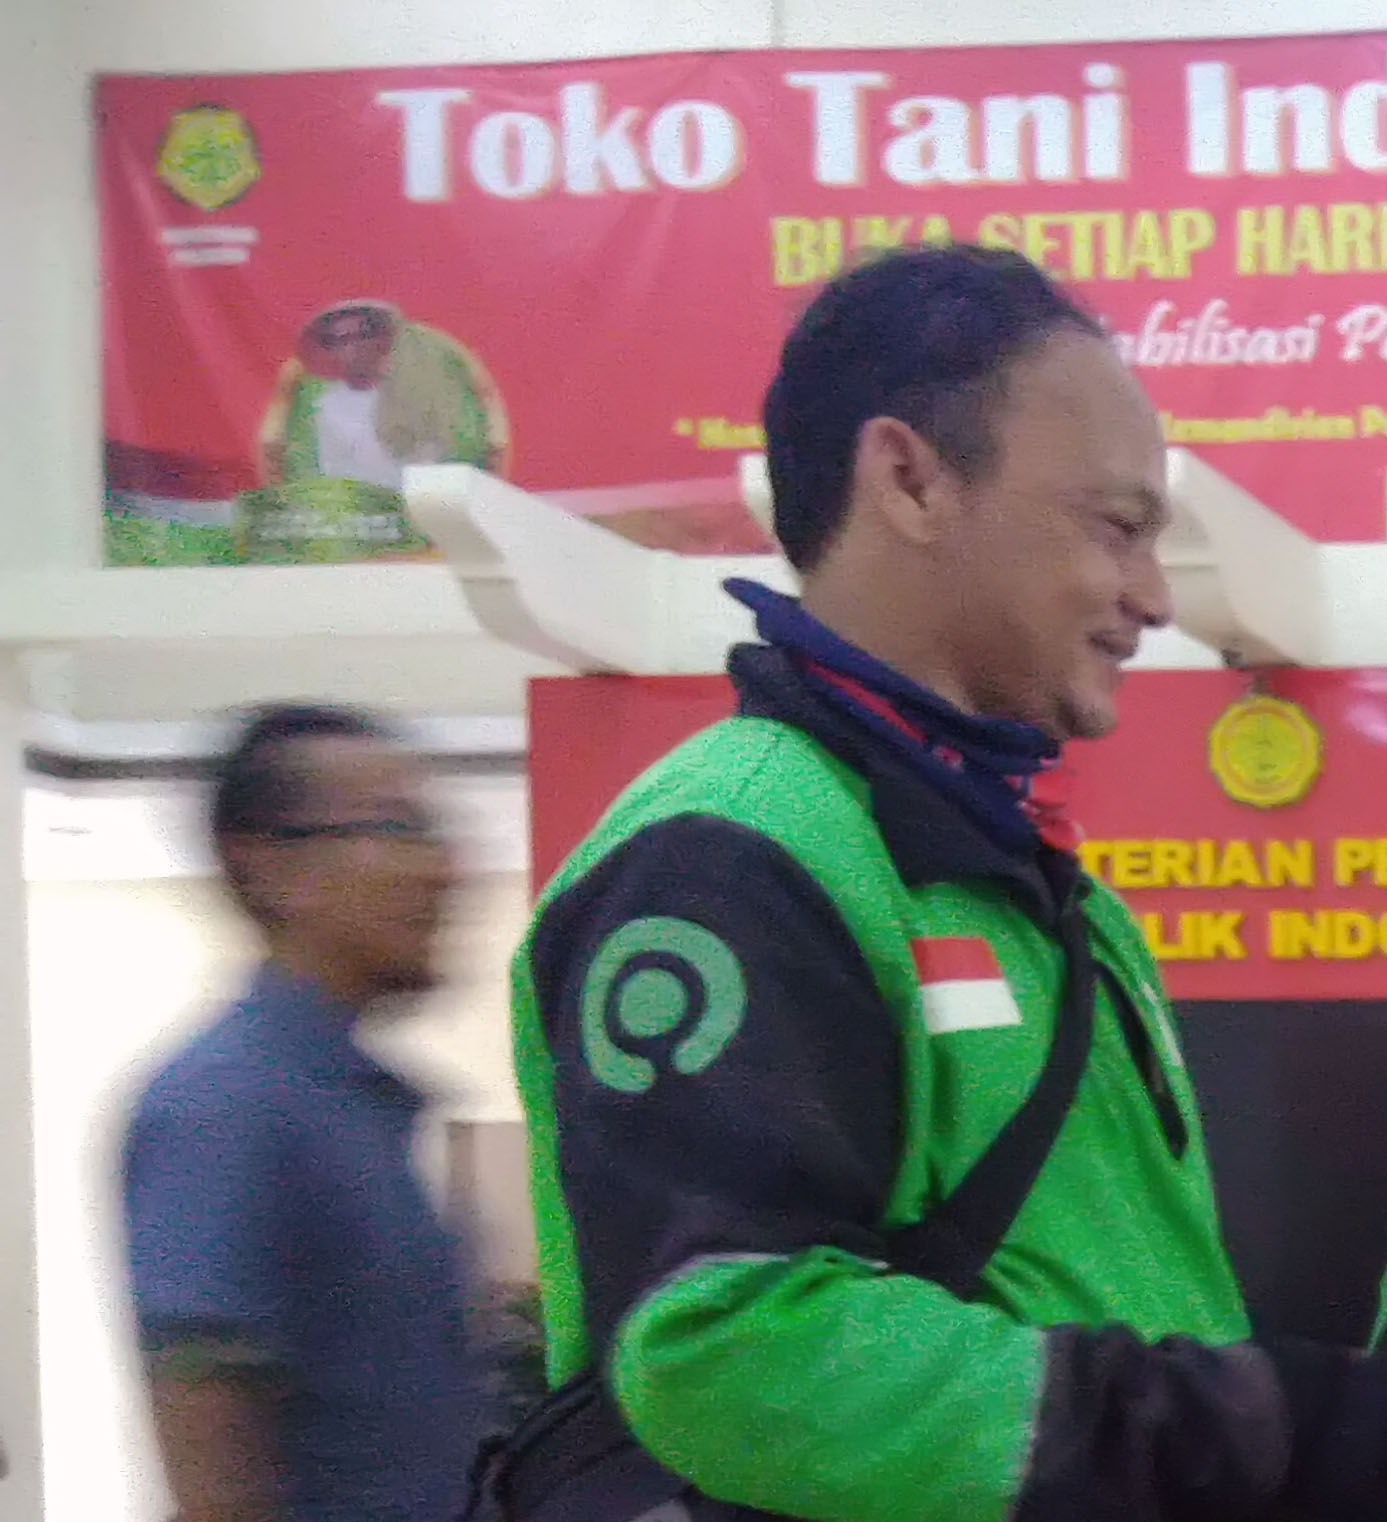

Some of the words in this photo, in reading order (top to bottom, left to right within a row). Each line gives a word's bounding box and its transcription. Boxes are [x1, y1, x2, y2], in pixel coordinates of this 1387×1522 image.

[377, 80, 745, 201] Toko
[785, 62, 1124, 187] Tani
[1076, 837, 1315, 890] TERIAN
